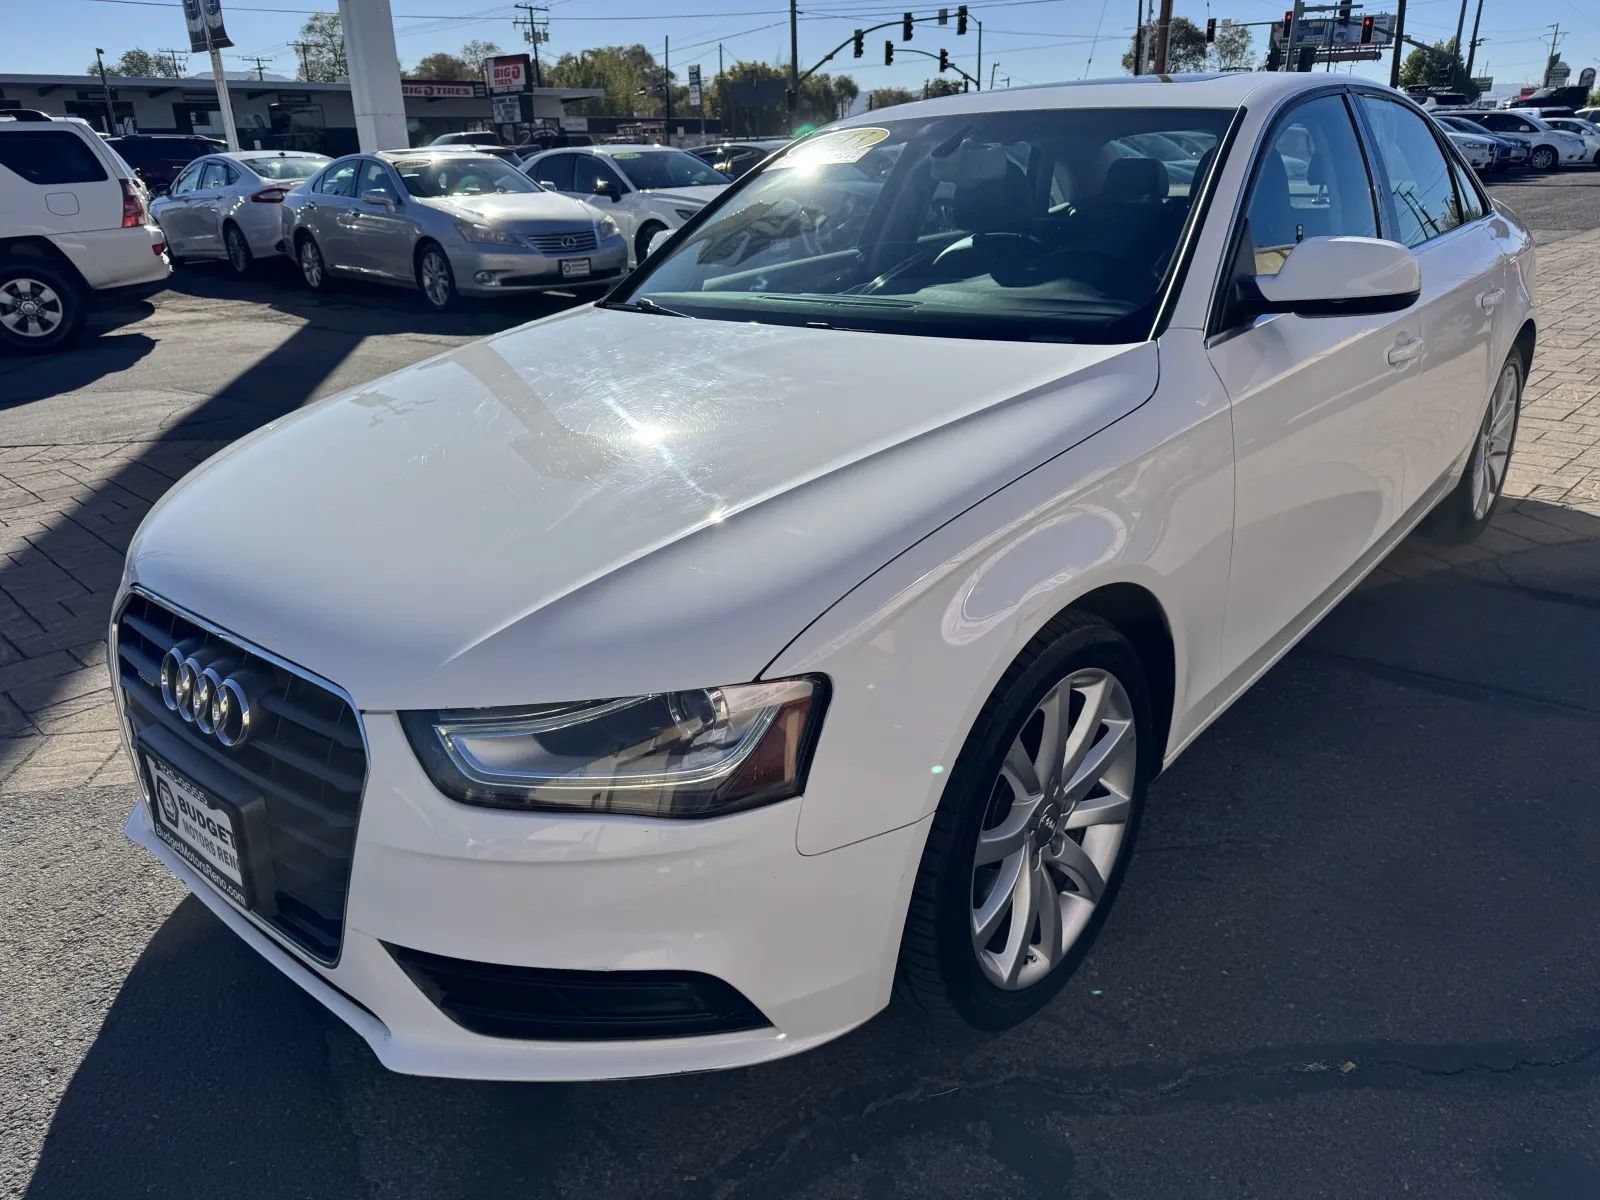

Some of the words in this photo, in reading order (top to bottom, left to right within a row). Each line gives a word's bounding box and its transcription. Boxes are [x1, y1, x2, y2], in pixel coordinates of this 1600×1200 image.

[494, 67, 511, 79] BIG
[494, 78, 513, 86] TIRES
[436, 87, 470, 95] TIRES
[177, 794, 236, 851] BUDGET
[182, 818, 217, 857] MOTORS
[156, 823, 247, 907] BudgetMotorsReno.com
